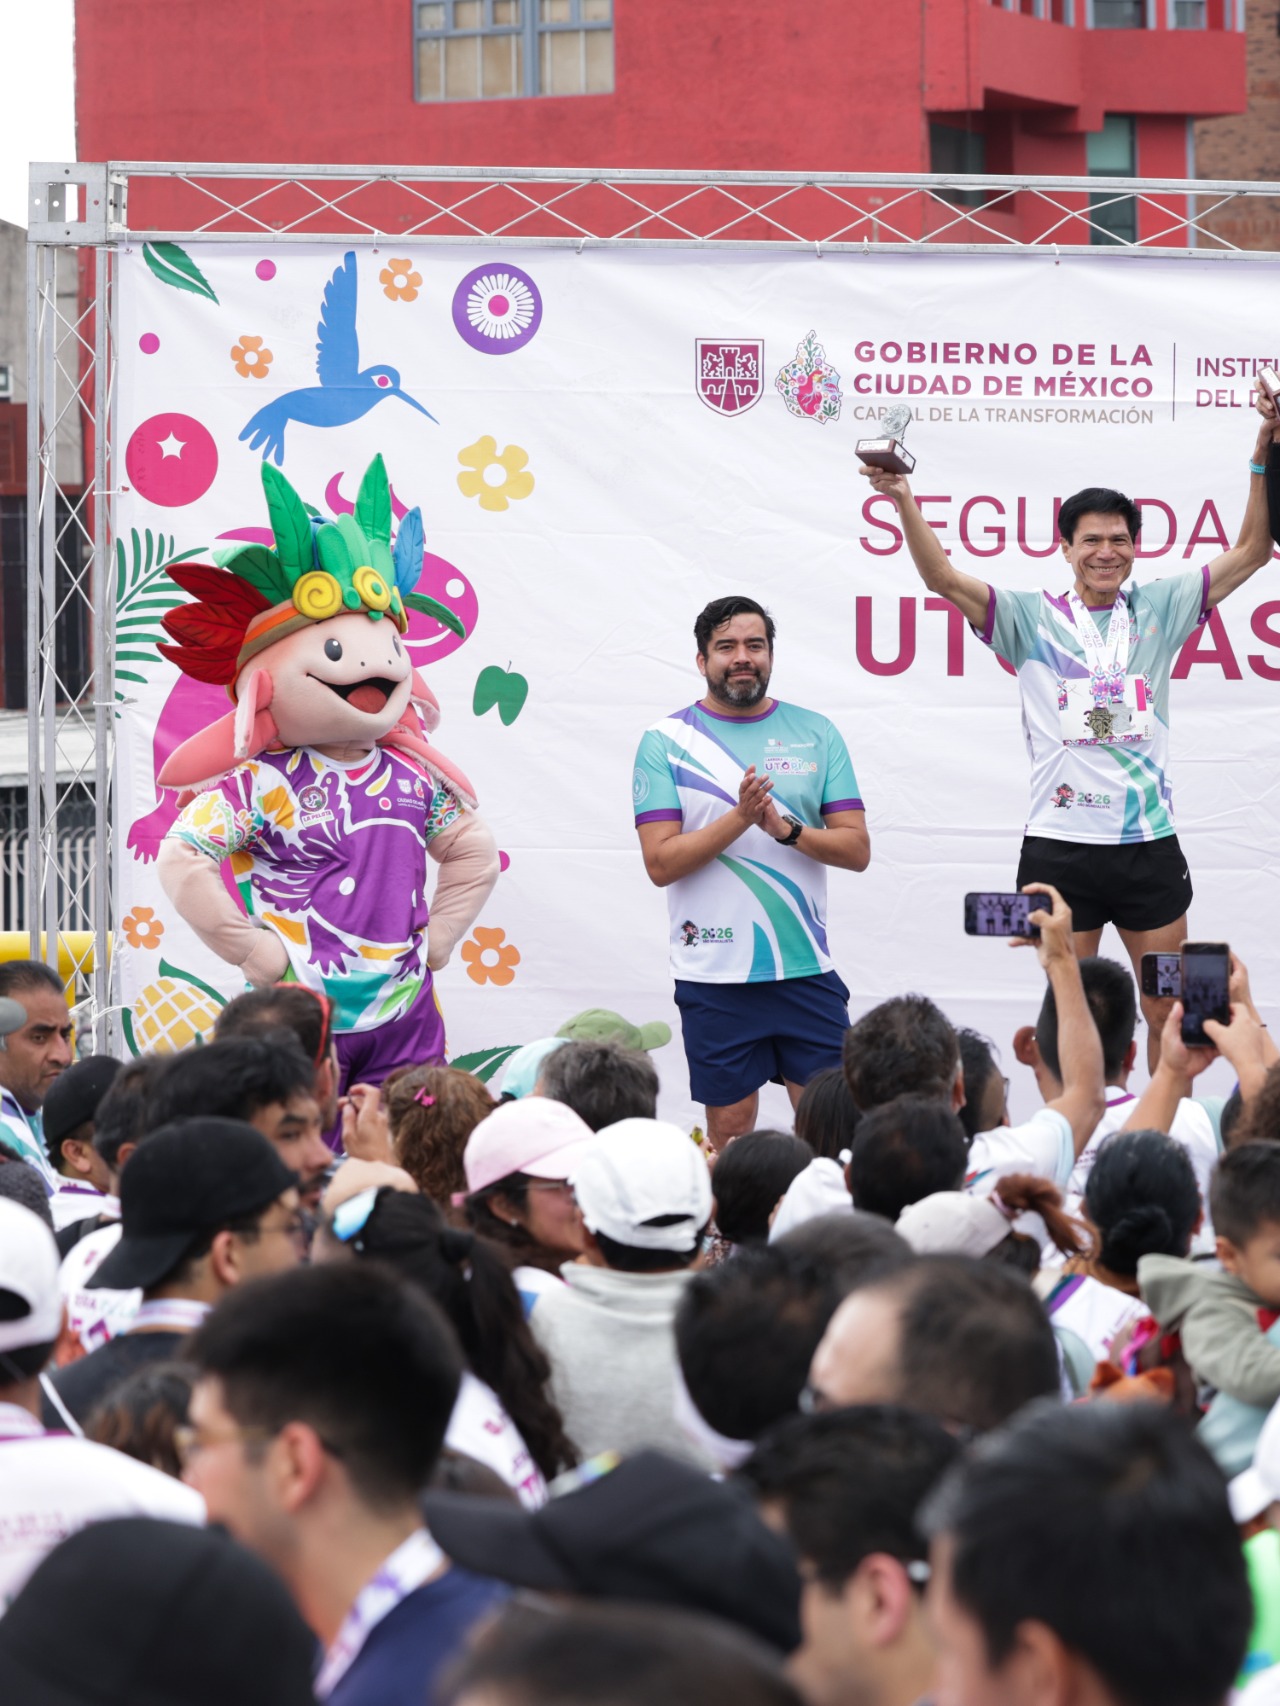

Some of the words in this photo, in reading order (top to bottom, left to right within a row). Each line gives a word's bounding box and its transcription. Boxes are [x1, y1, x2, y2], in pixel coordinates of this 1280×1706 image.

[855, 341, 1037, 364] GOBIERNO
[1052, 344, 1095, 365] DE
[1111, 345, 1153, 366] LA
[854, 374, 971, 395] CIUDAD
[983, 375, 1022, 395] DE
[1035, 371, 1153, 397] MÉXICO
[1197, 389, 1241, 407] DEL
[929, 407, 952, 422] DE
[958, 407, 980, 422] LA
[984, 405, 1153, 424] TRANSFORMACIÓN
